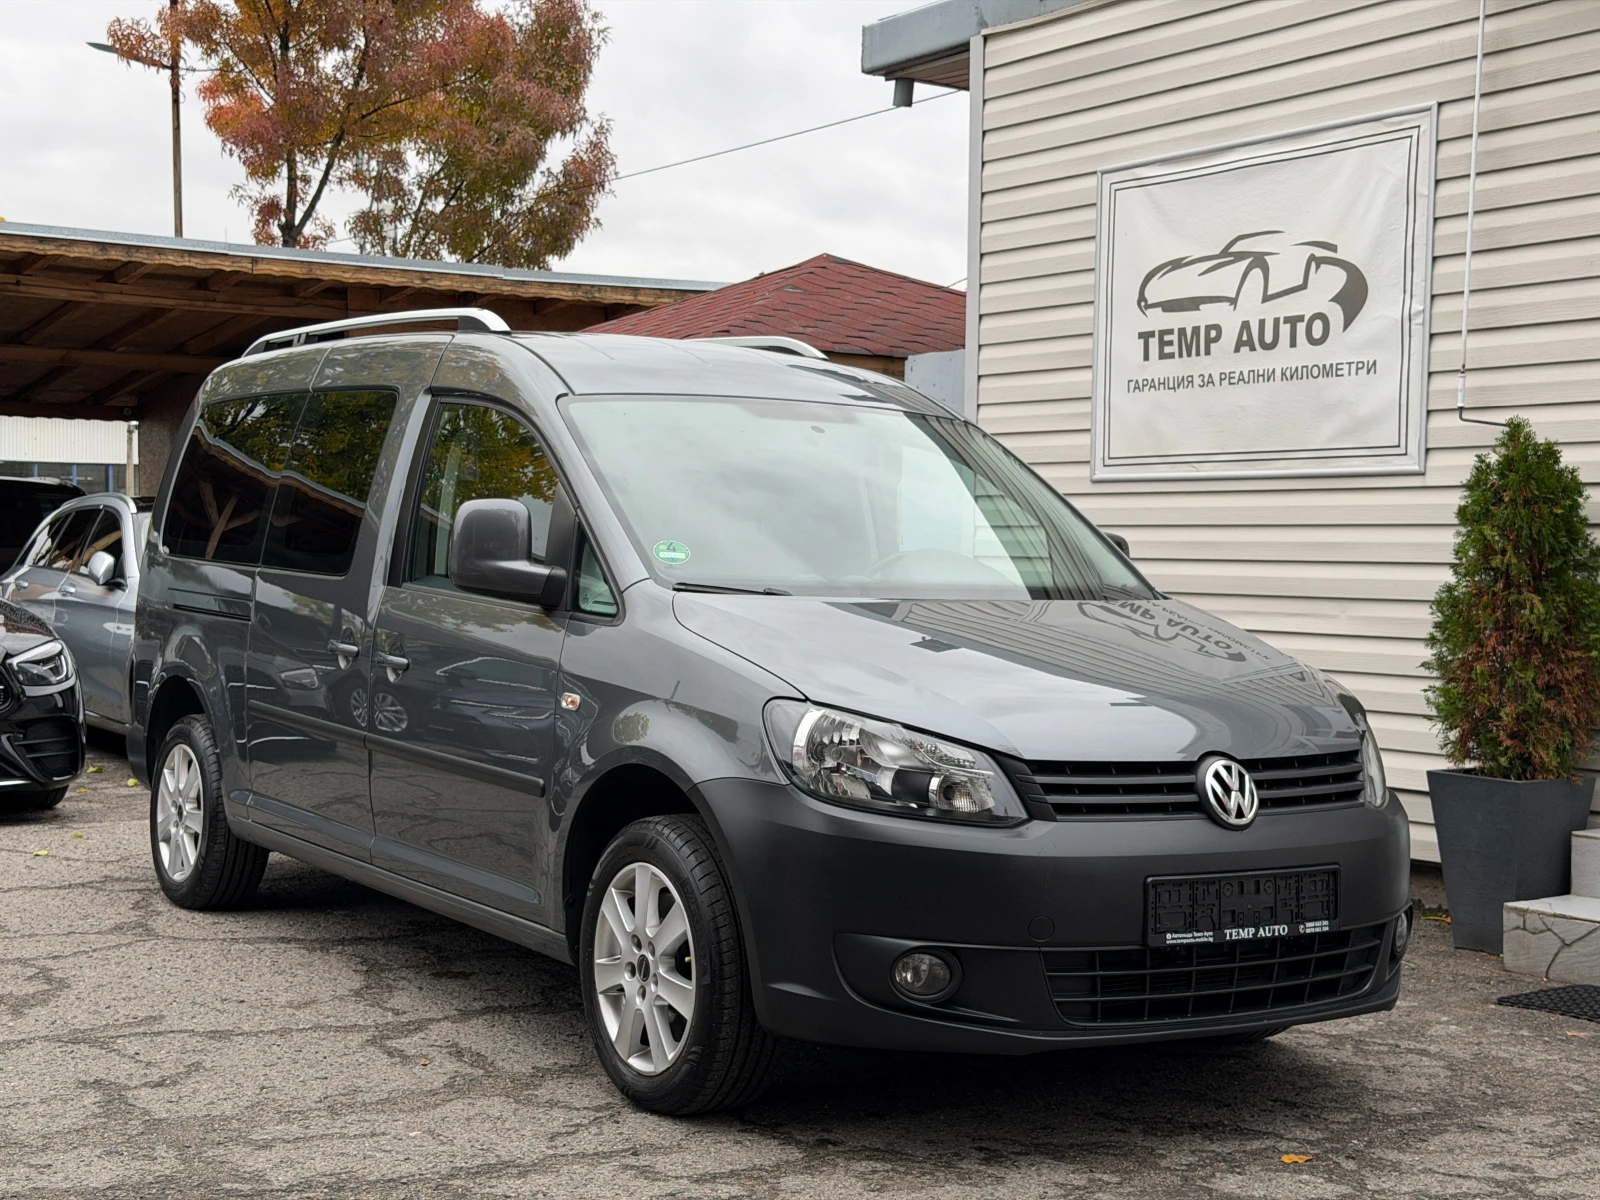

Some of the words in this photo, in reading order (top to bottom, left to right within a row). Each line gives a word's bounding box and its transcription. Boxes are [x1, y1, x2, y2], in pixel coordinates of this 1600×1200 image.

[1137, 323, 1223, 362] TEMP
[1233, 312, 1331, 353] AUTO
[1126, 374, 1194, 394] ГАРАНЦИЯ
[1198, 373, 1216, 388] ЗА
[1219, 368, 1276, 386] РЕАЛНИ
[1280, 360, 1378, 382] КИЛОМЕТРИ
[1224, 928, 1256, 940] TEMP
[1257, 925, 1288, 937] AUTO
